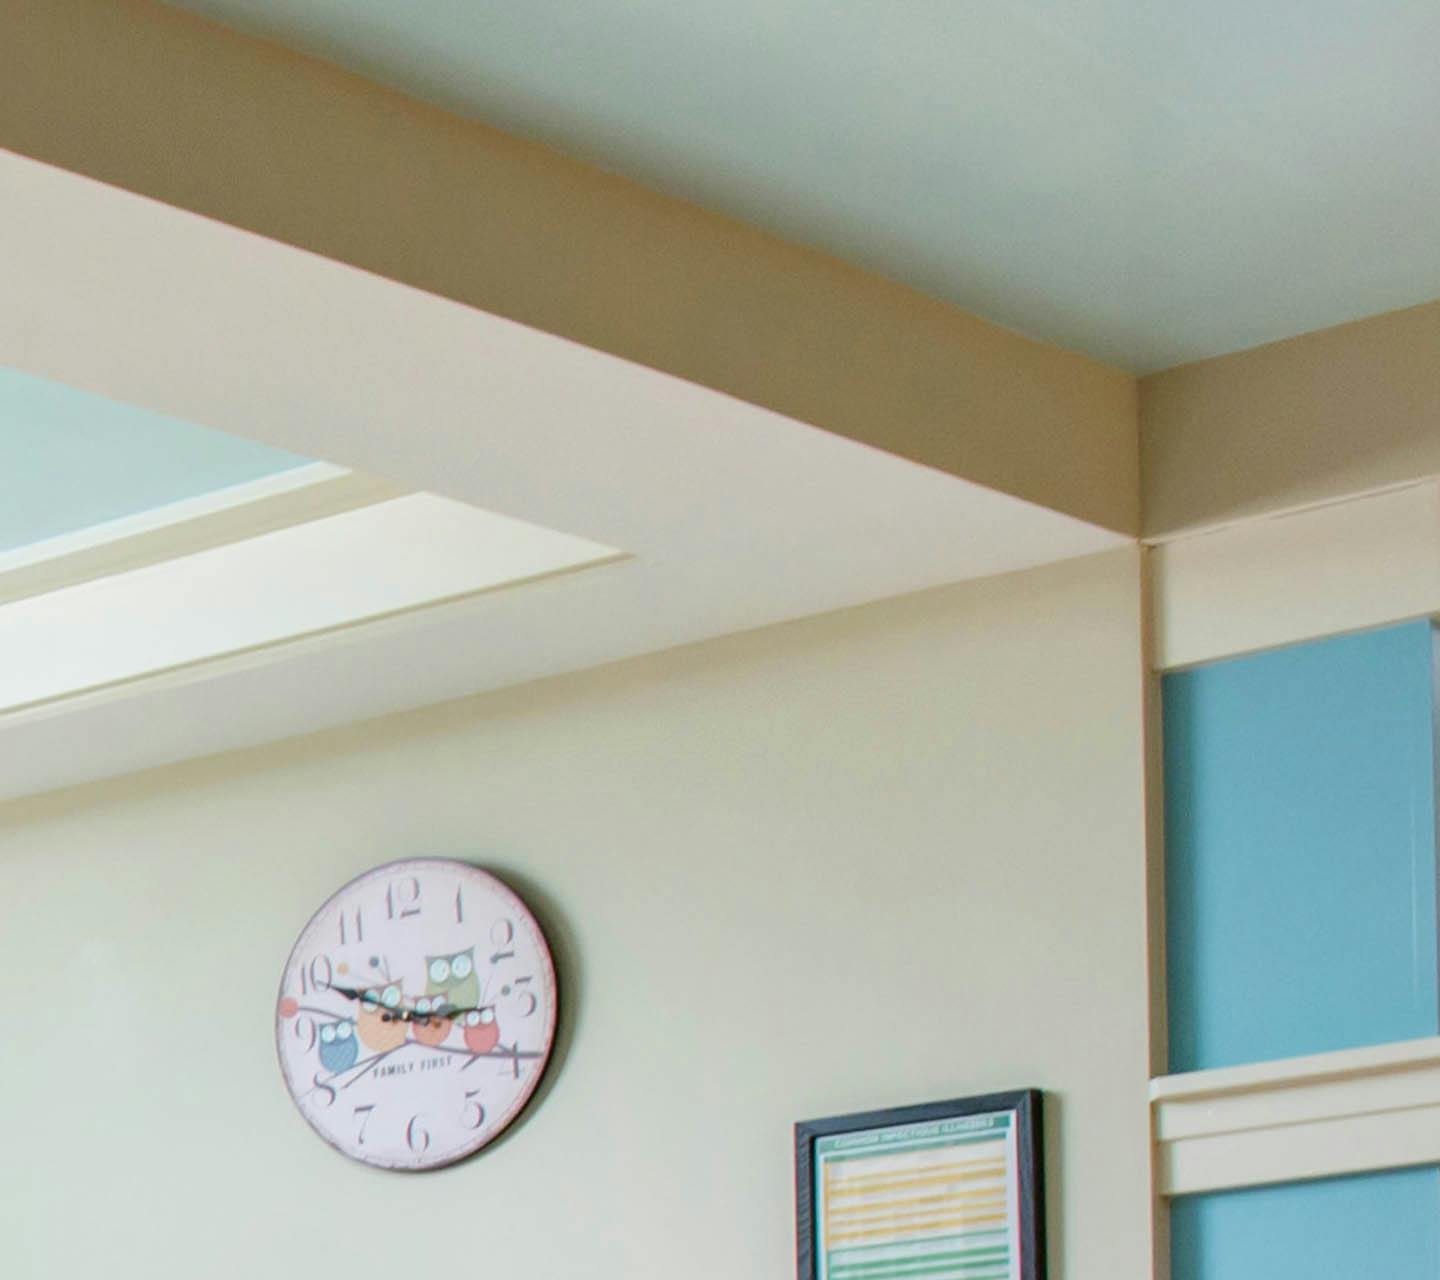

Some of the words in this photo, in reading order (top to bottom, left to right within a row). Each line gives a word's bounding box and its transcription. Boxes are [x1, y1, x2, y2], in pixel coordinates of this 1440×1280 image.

[386, 877, 421, 921] 12
[455, 883, 465, 924] 1
[339, 905, 362, 945] 11
[490, 918, 514, 964] 2
[300, 954, 332, 996] 10
[515, 975, 537, 1017] 3
[294, 1015, 317, 1052] 9
[373, 1061, 414, 1078] FAMILY
[420, 1056, 453, 1073] FIRST
[498, 1040, 526, 1080] 4
[312, 1071, 336, 1106] 8
[354, 1104, 376, 1145] 7
[463, 1090, 485, 1130] 5
[406, 1113, 430, 1153] 6
